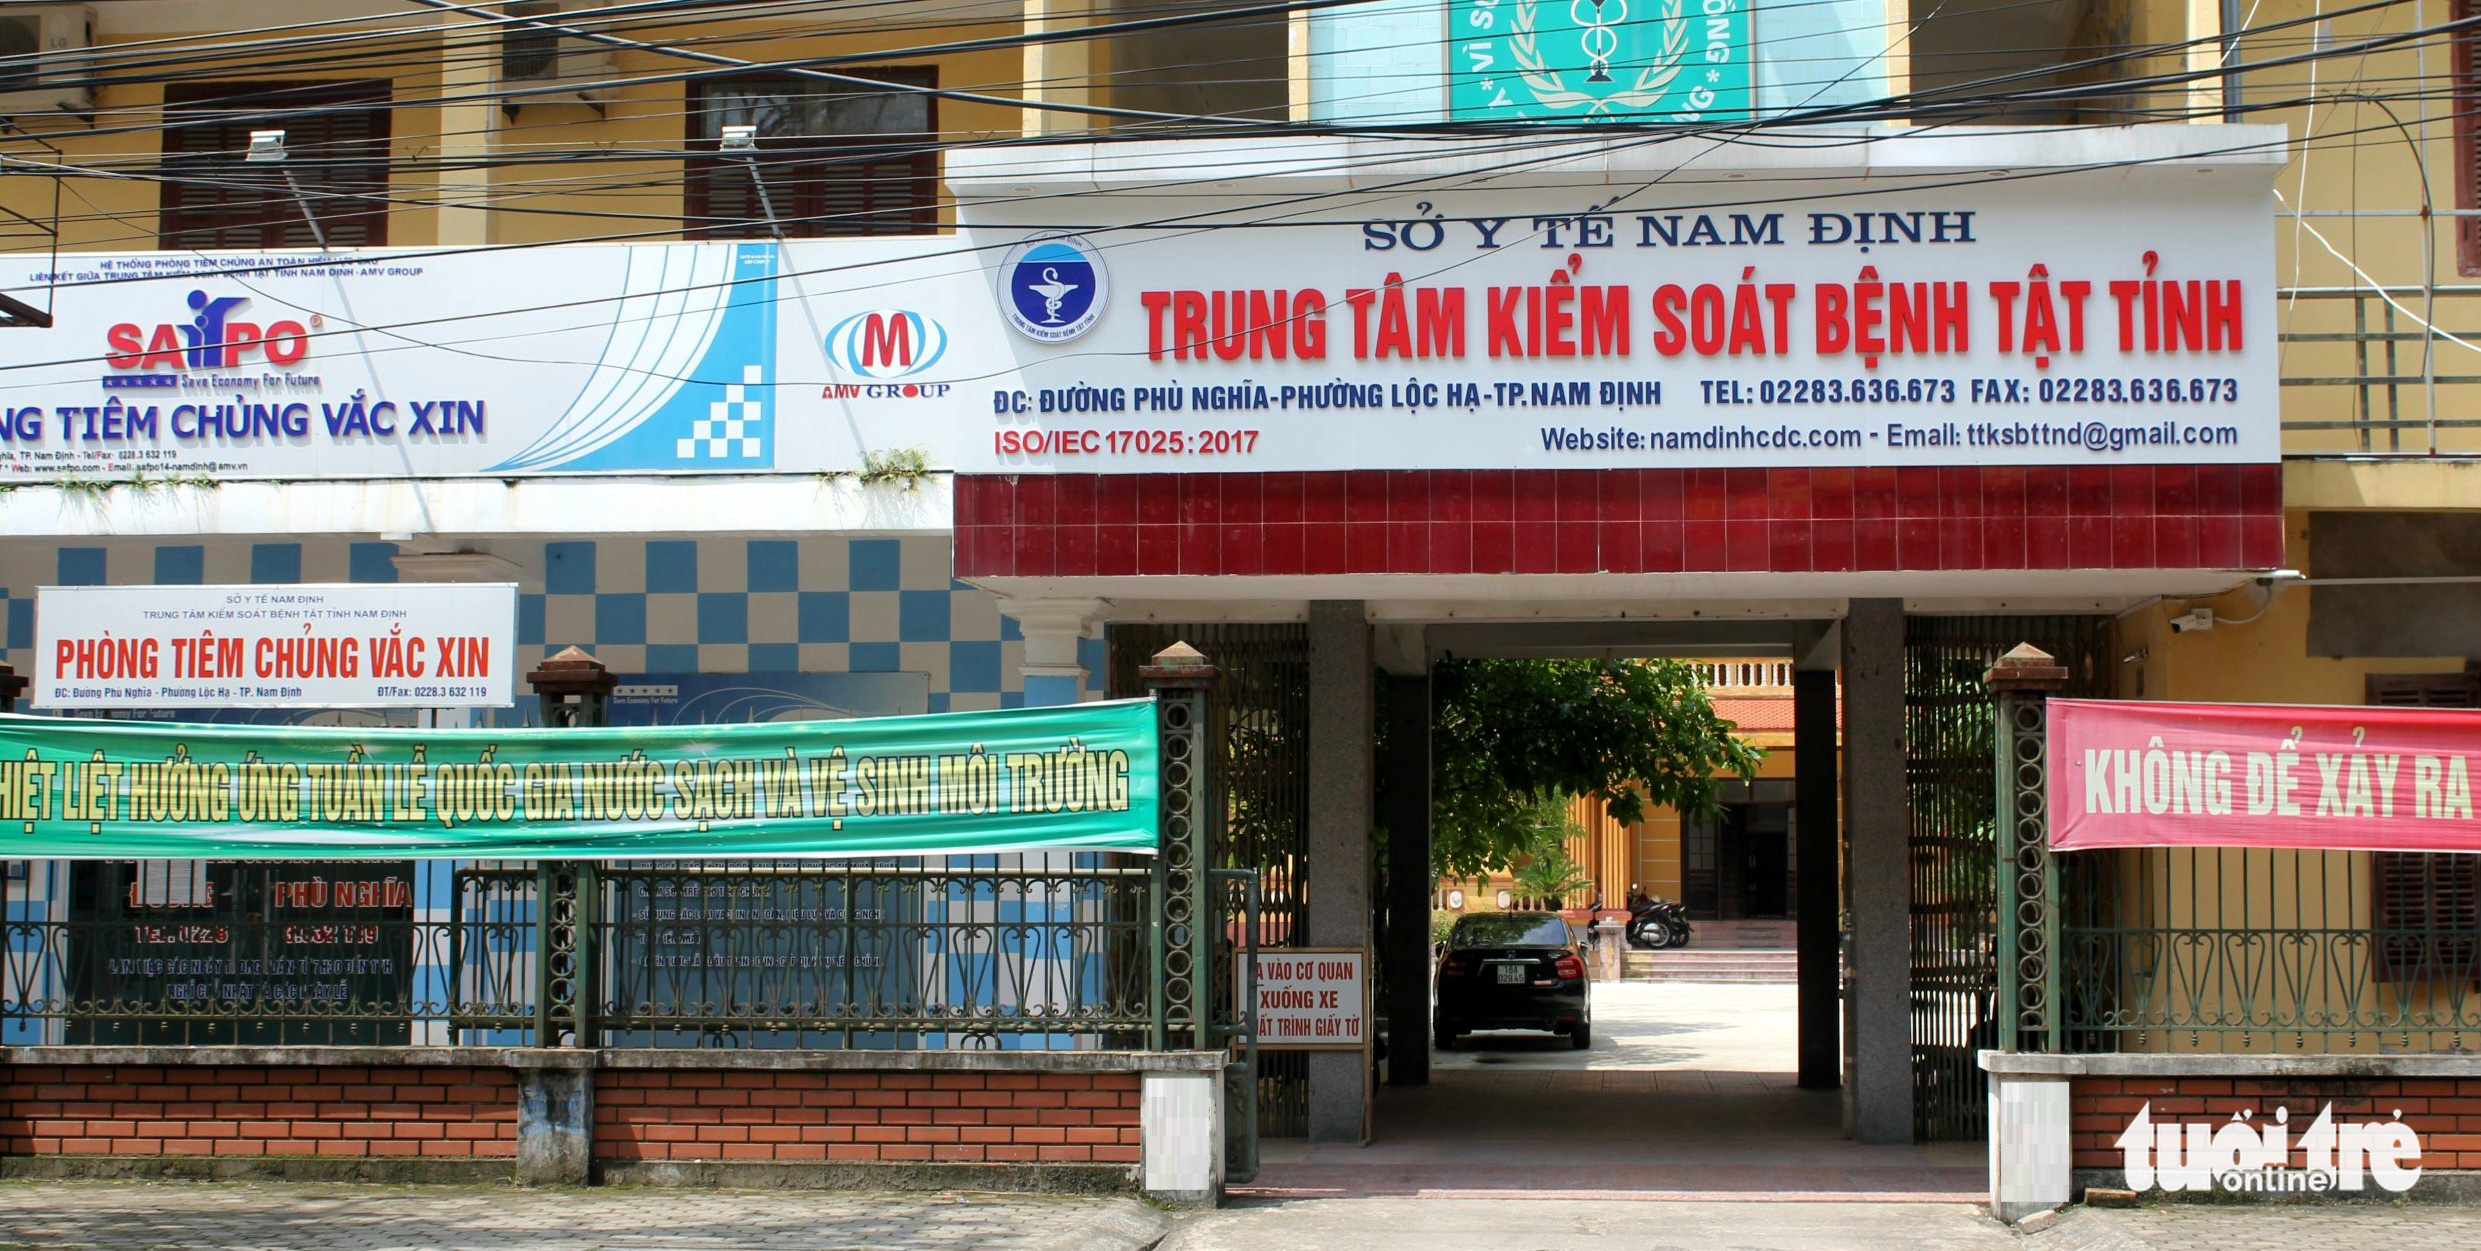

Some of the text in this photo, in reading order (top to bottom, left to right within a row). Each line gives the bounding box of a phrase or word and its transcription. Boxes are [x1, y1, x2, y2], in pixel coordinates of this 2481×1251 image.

[50, 37, 68, 48] LG
[1462, 42, 1494, 73] VÌ
[1363, 197, 1977, 253] SỞ Y TẾ NAM ĐỊNH
[258, 257, 273, 266] AN
[300, 268, 325, 277] NAM
[360, 268, 385, 276] AMV
[387, 267, 424, 276] GROUP
[1140, 250, 2242, 368] TRUNG TÂM KIỂM SOÁT BỆNH TẬT TỈNH
[181, 372, 320, 390] Save Economy For Future
[822, 383, 951, 399] AMV GROUP
[994, 390, 1033, 415] ĐC:
[1039, 381, 1125, 413] ĐƯỜNG
[1134, 379, 1183, 412] PHÙ
[1391, 377, 1438, 415] LỘC
[1599, 381, 1661, 413] ĐỊNH
[1759, 379, 1956, 405] 02283.636.673
[1971, 379, 2030, 404] FAX:
[2038, 378, 2238, 403] 02283.636.673
[56, 396, 158, 441] TIÊM
[171, 394, 309, 440] CHỦNG
[322, 387, 396, 438] VẮC
[408, 400, 486, 436] XIN
[994, 430, 1100, 456] ISO/IEC
[1199, 429, 1259, 455] 2017
[1650, 425, 1862, 450] namdinhcdc.com
[1887, 423, 1962, 449] Email:
[1966, 421, 2238, 453] ttksbttnd@gmail.com
[34, 451, 54, 461] Nam
[146, 450, 161, 460] 632
[163, 450, 177, 459] 119
[226, 592, 324, 606] SỞ Y TẾ NAM ĐỊNH
[144, 610, 180, 619] TRUNG
[182, 608, 205, 619] TÂM
[208, 605, 235, 619] KIỂM
[237, 607, 267, 619] SOÁT
[270, 608, 300, 620] BỆNH
[303, 608, 323, 620] TẬT
[354, 609, 378, 618] NAM
[381, 609, 407, 620] ĐỊNH
[55, 621, 490, 680] PHÒNG TIÊM CHỦNG VẮC XIN
[54, 687, 71, 698] ĐC:
[199, 686, 215, 699] Lộc
[218, 687, 230, 699] Hạ
[240, 687, 253, 698] TP.
[256, 687, 278, 697] Nam
[280, 686, 302, 699] Định
[377, 686, 412, 697] ĐT/Fax:
[414, 686, 446, 697] 0228.3
[449, 686, 466, 697] 632
[470, 686, 487, 697] 119
[2085, 726, 2473, 820] KHÔNG ĐỂ XẢY RA
[63, 749, 124, 835] LIỆT
[129, 744, 230, 823] HƯỞNG
[237, 751, 301, 822] ỨNG
[305, 744, 389, 824] TUẦN
[393, 744, 428, 821] LỄ
[436, 743, 517, 830] QUỐC
[524, 761, 577, 822] GIA
[582, 748, 666, 821] NƯỚC
[674, 757, 755, 832] SẠCH
[761, 746, 802, 818] VÀ
[809, 745, 849, 831] VỆ
[855, 754, 932, 817] SINH
[937, 743, 1000, 815] MÔI
[1004, 737, 1131, 815] TRƯỜNG
[274, 876, 327, 908] PHÙ
[1267, 958, 1353, 982] VÀO CƠ QUAN
[1260, 984, 1339, 1009] XUỐNG XE
[1278, 1012, 1360, 1036] TRÌNH GIẤY TỜ
